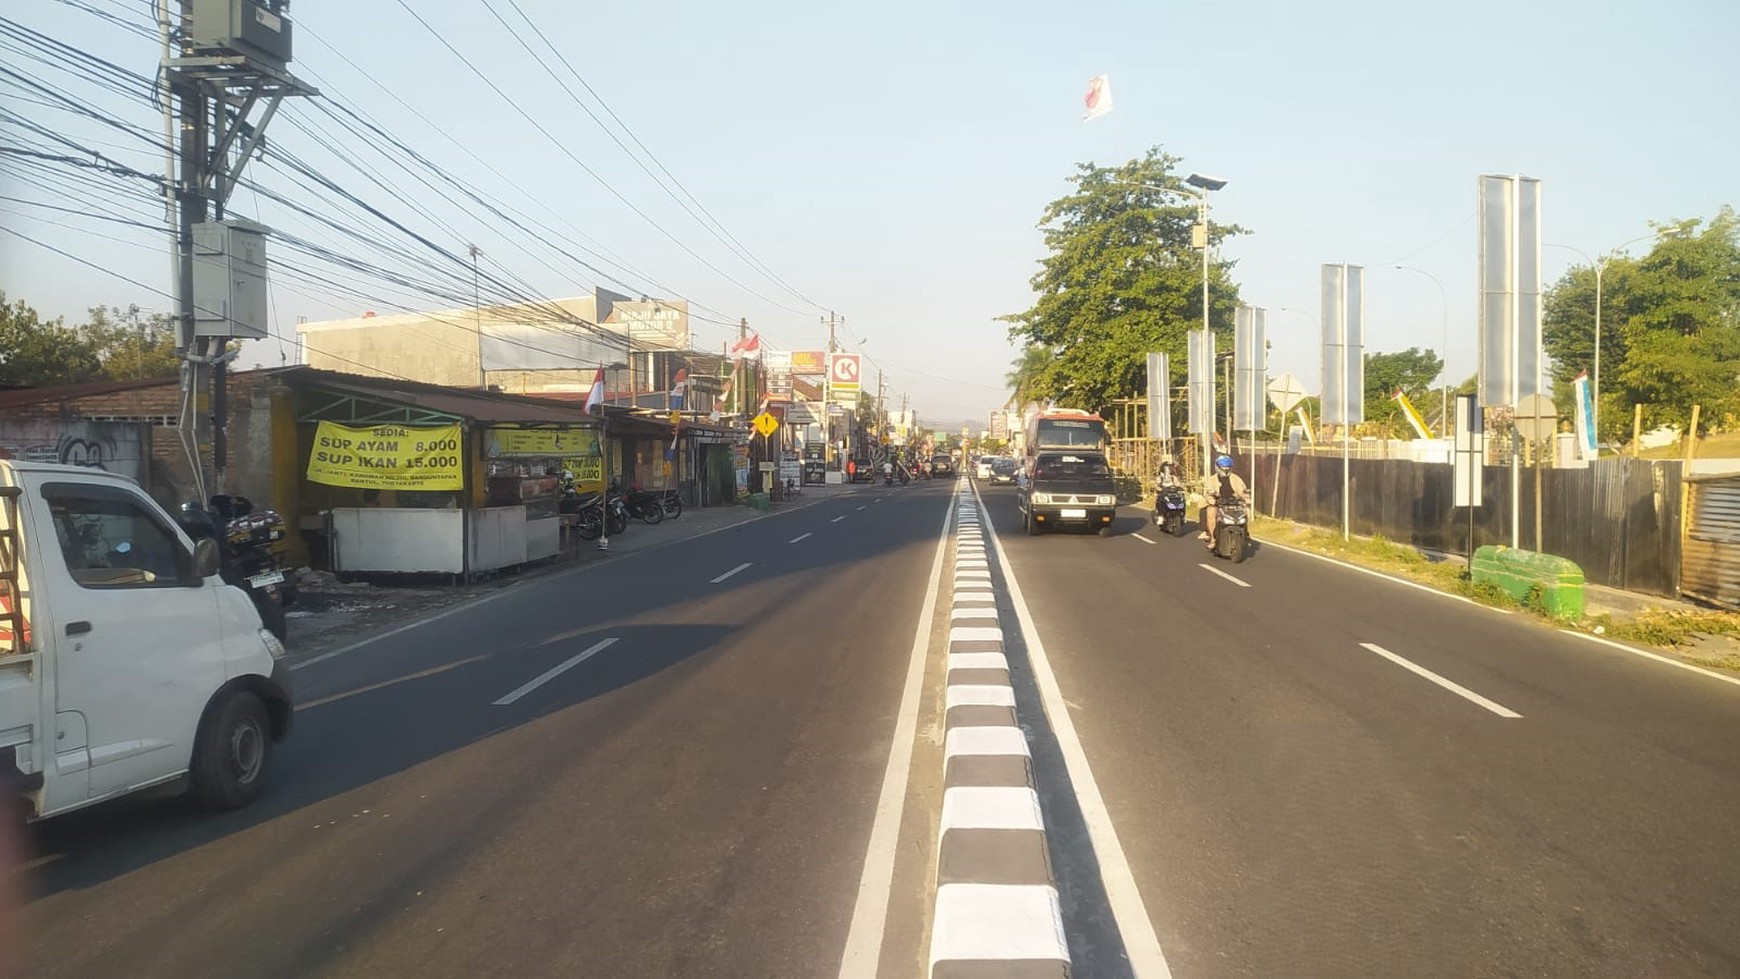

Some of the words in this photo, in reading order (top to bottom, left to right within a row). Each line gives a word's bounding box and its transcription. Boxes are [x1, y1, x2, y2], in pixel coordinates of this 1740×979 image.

[653, 310, 680, 321] JAYA
[665, 320, 674, 330] 2
[373, 428, 409, 437] SEDIA:
[320, 437, 352, 449] SUP
[356, 441, 399, 452] AYAM
[415, 439, 457, 452] 8.000
[317, 451, 353, 465] SUP
[358, 456, 397, 468] IKAN
[406, 456, 458, 468] 15.000
